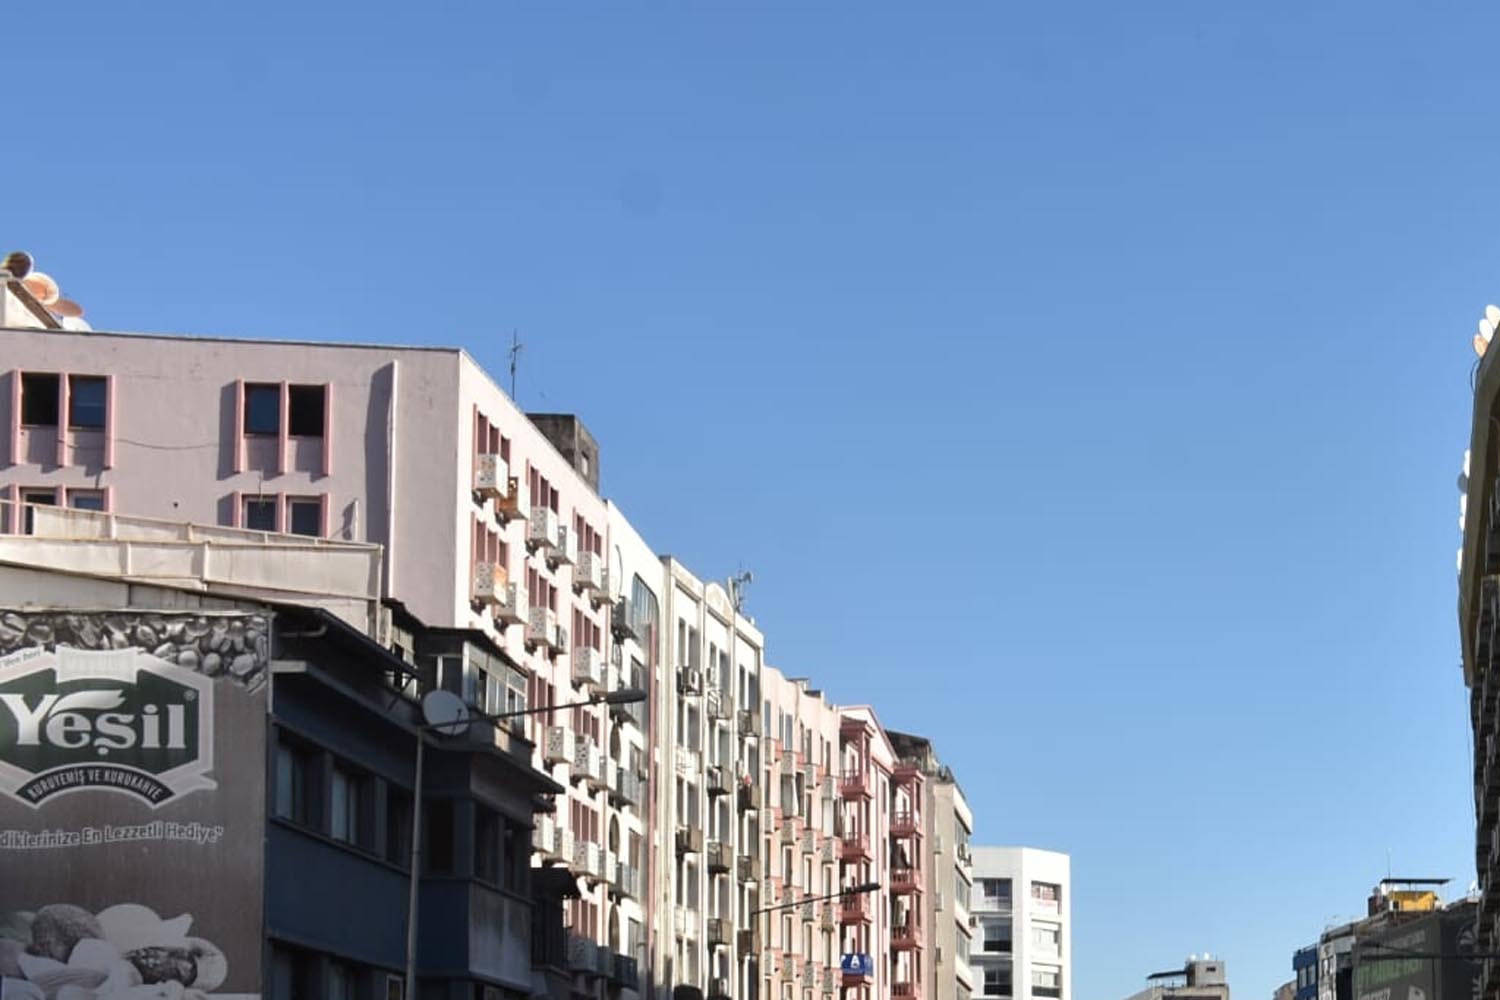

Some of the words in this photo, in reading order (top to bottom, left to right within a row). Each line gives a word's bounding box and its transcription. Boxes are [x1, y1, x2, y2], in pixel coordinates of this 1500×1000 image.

[0, 692, 187, 755] Yeşil
[27, 767, 86, 801] KURUYEMİŞ
[87, 768, 101, 782] VE
[104, 768, 163, 800] KURUKAHVE
[82, 826, 102, 844] En
[104, 820, 164, 842] Lezzetli
